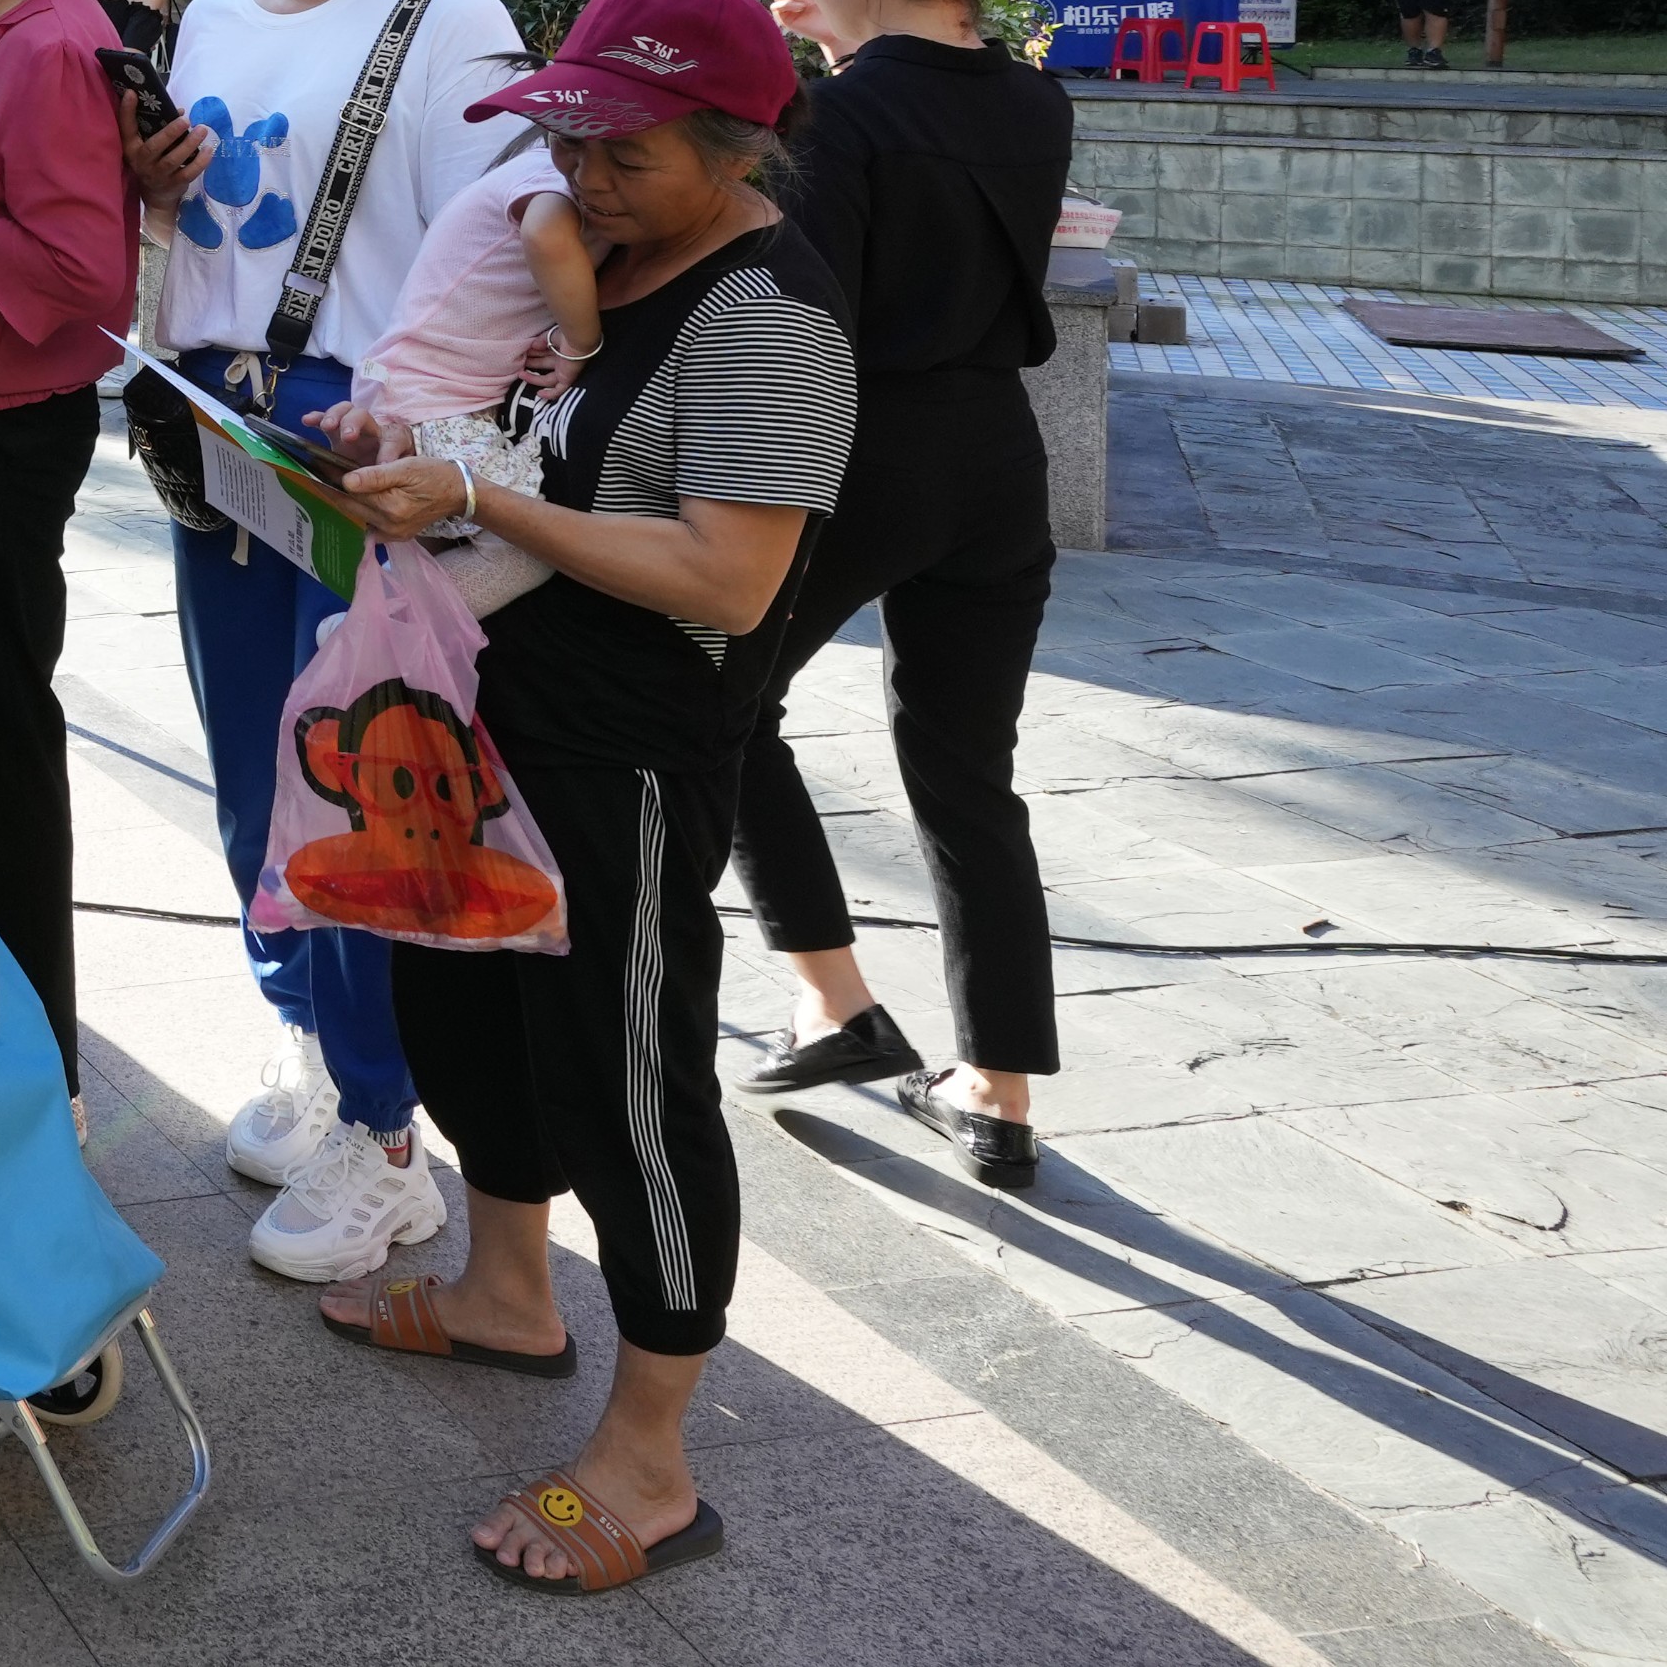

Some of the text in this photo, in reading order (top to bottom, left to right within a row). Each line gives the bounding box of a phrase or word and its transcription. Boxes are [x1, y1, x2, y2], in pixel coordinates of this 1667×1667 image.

[1063, 1, 1174, 27] 柏乐口腔
[598, 1516, 622, 1539] SUM
